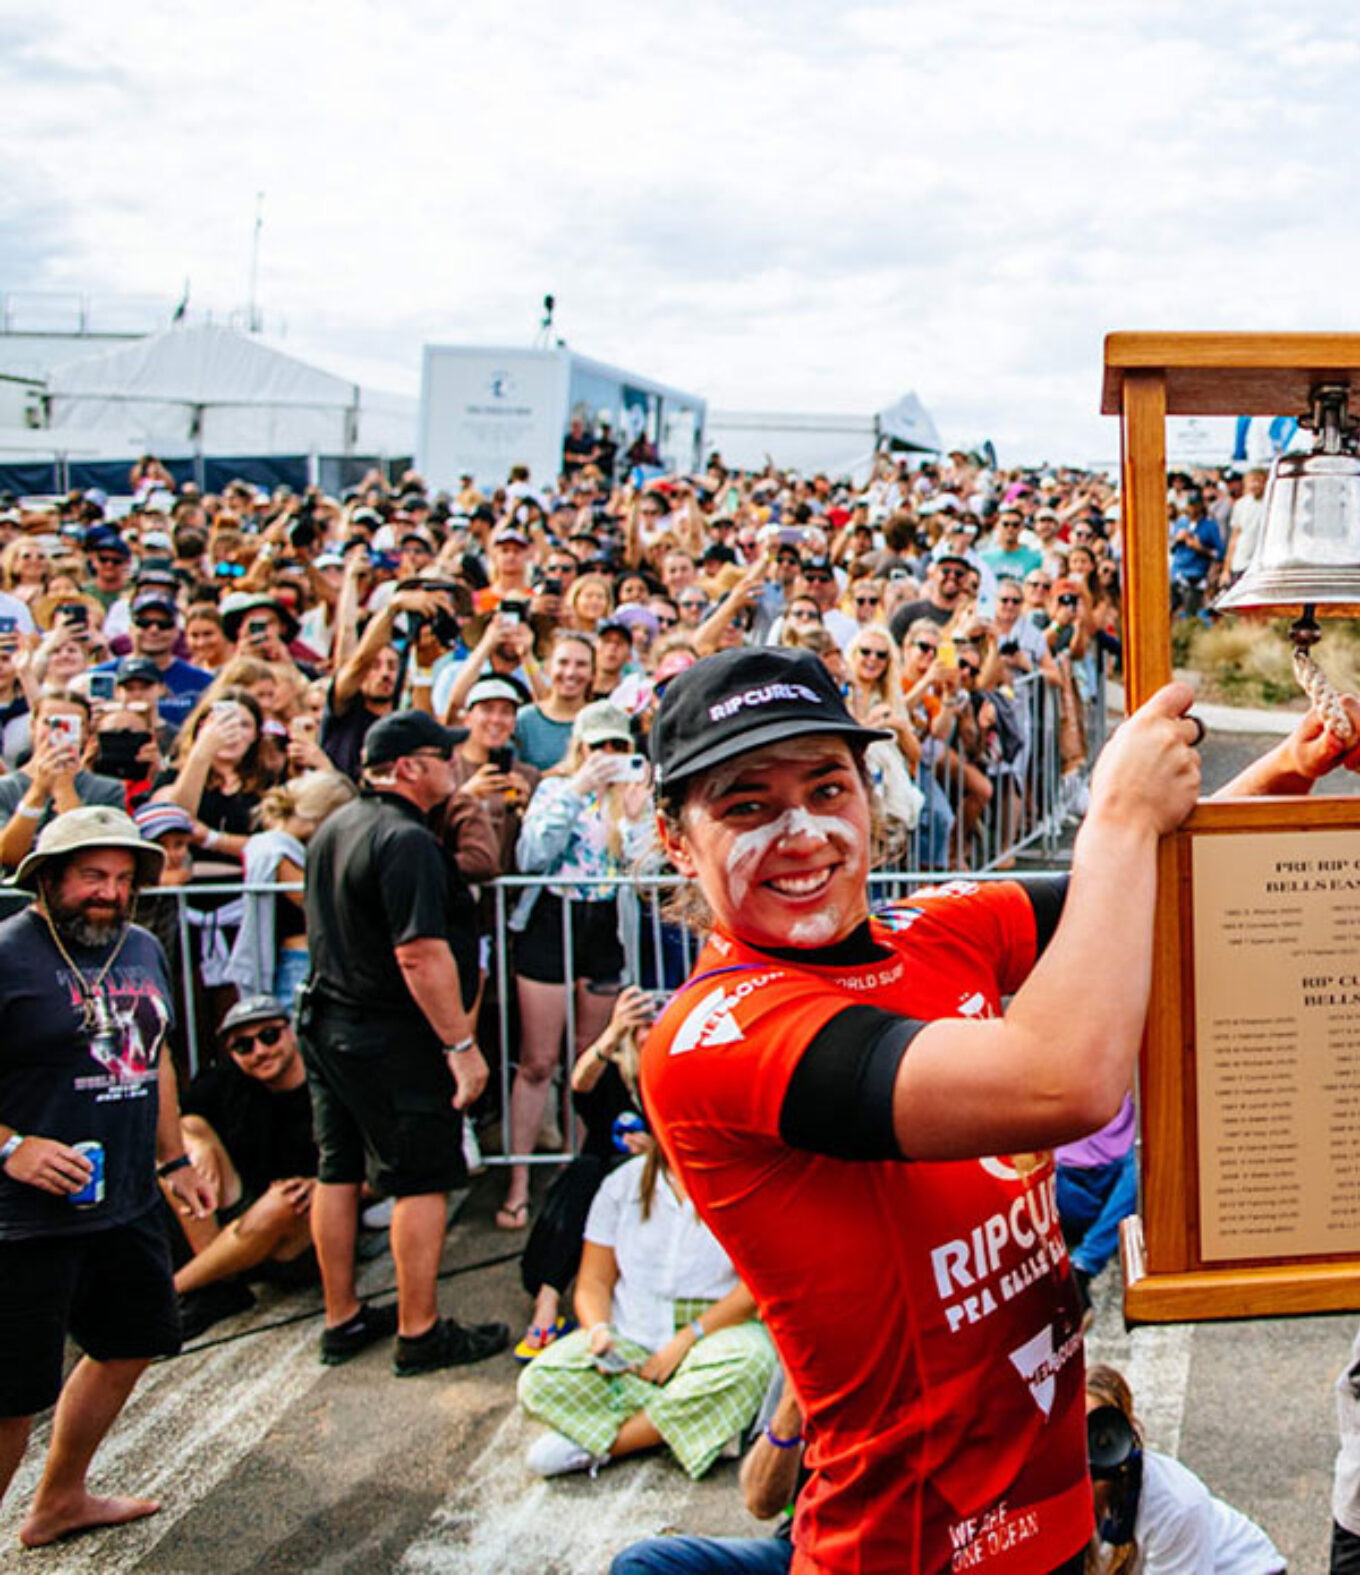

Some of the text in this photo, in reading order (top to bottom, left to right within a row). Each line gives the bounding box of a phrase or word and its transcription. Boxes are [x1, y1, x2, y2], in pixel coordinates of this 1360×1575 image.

[709, 684, 798, 721] RIP CURL
[1275, 861, 1314, 873] PRE
[1318, 859, 1349, 872] RIP
[1266, 879, 1328, 893] BELLS
[1302, 975, 1333, 989] RIP
[931, 1213, 1008, 1299] RIP
